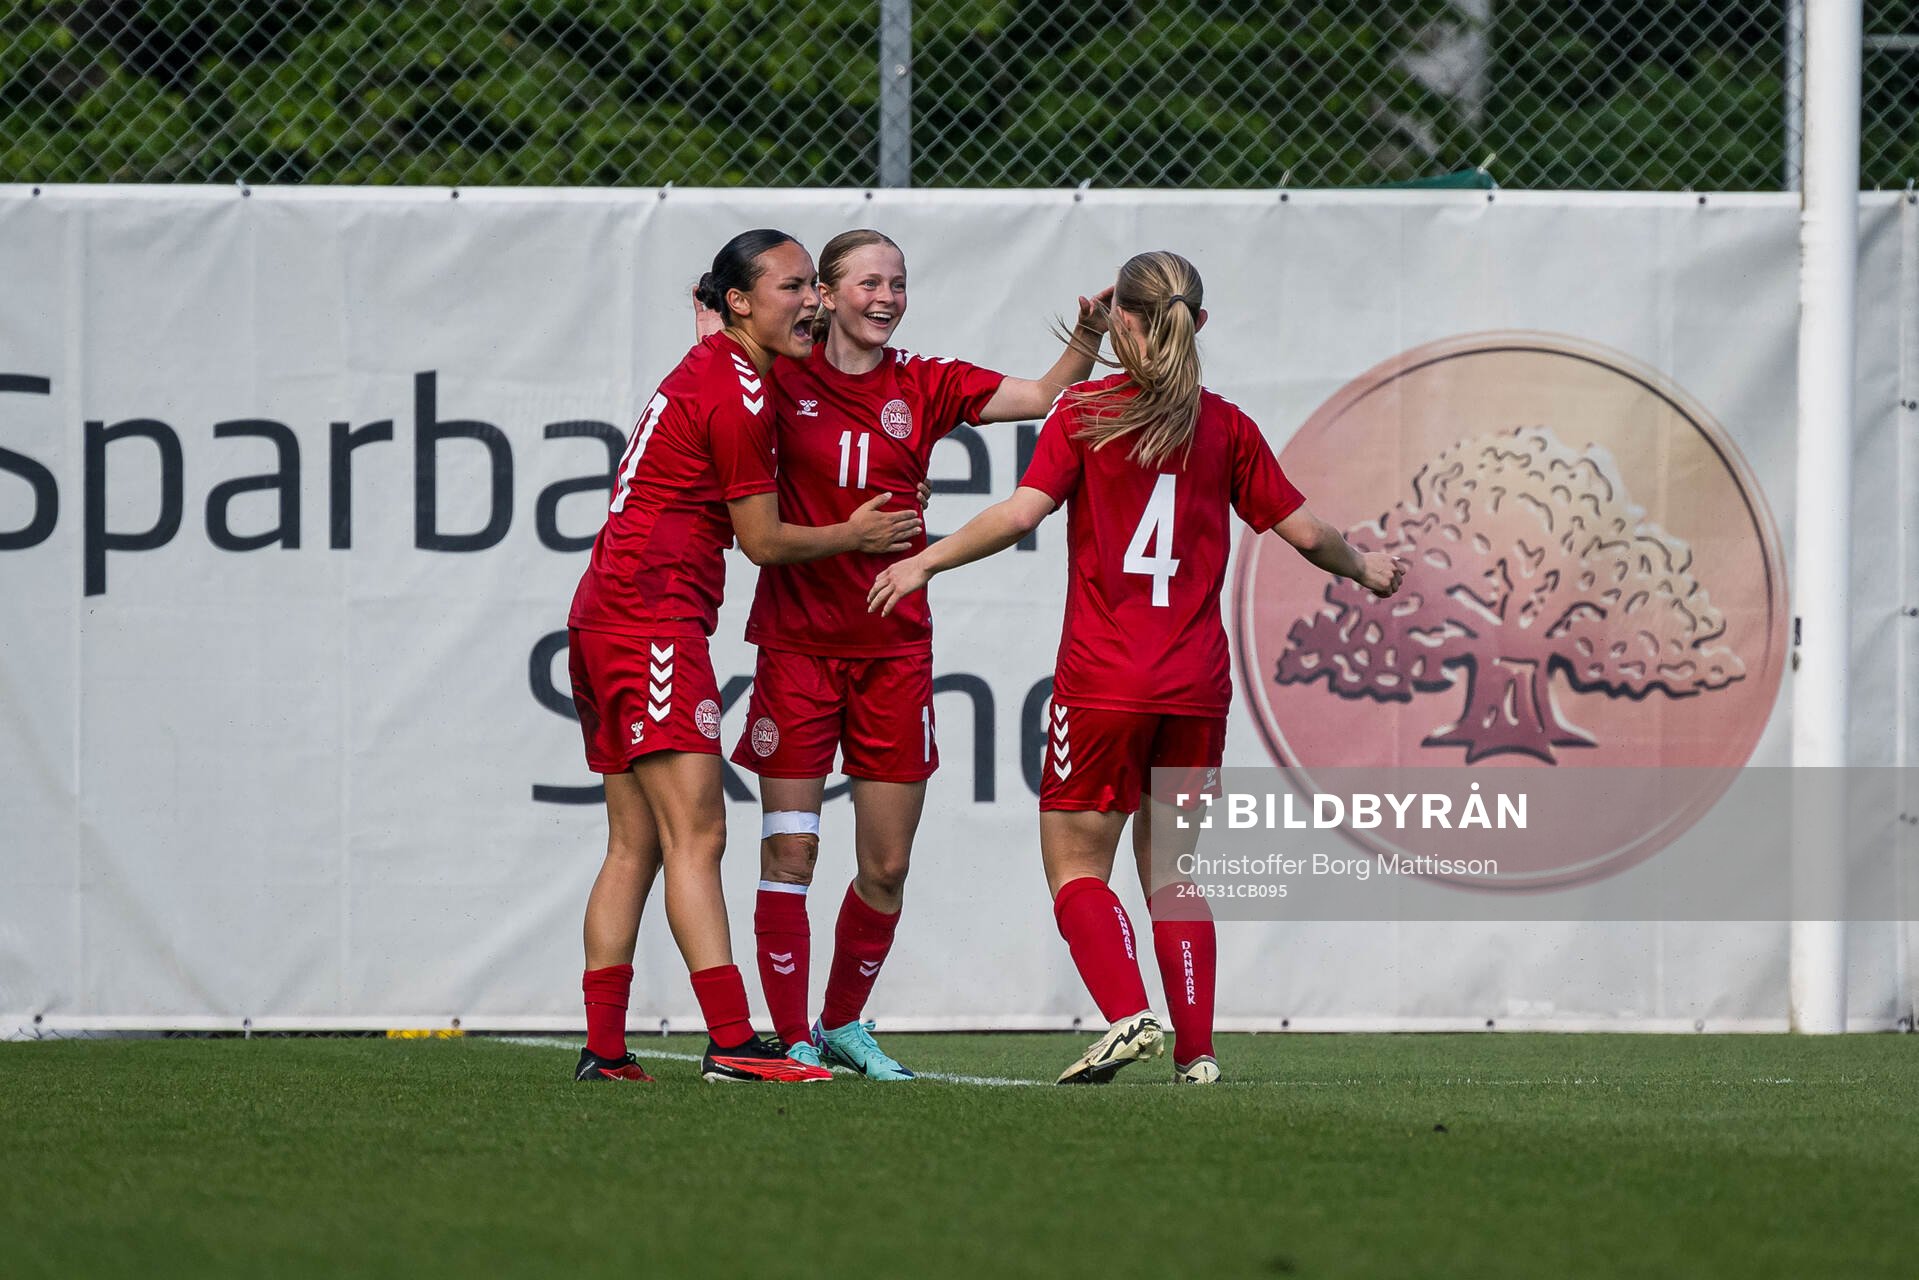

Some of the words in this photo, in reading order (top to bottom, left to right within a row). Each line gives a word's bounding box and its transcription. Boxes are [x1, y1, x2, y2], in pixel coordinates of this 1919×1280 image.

[838, 430, 870, 489] 11
[1123, 473, 1180, 607] 4
[1113, 905, 1135, 961] DANMARK
[1181, 940, 1197, 1005] DANMARK
